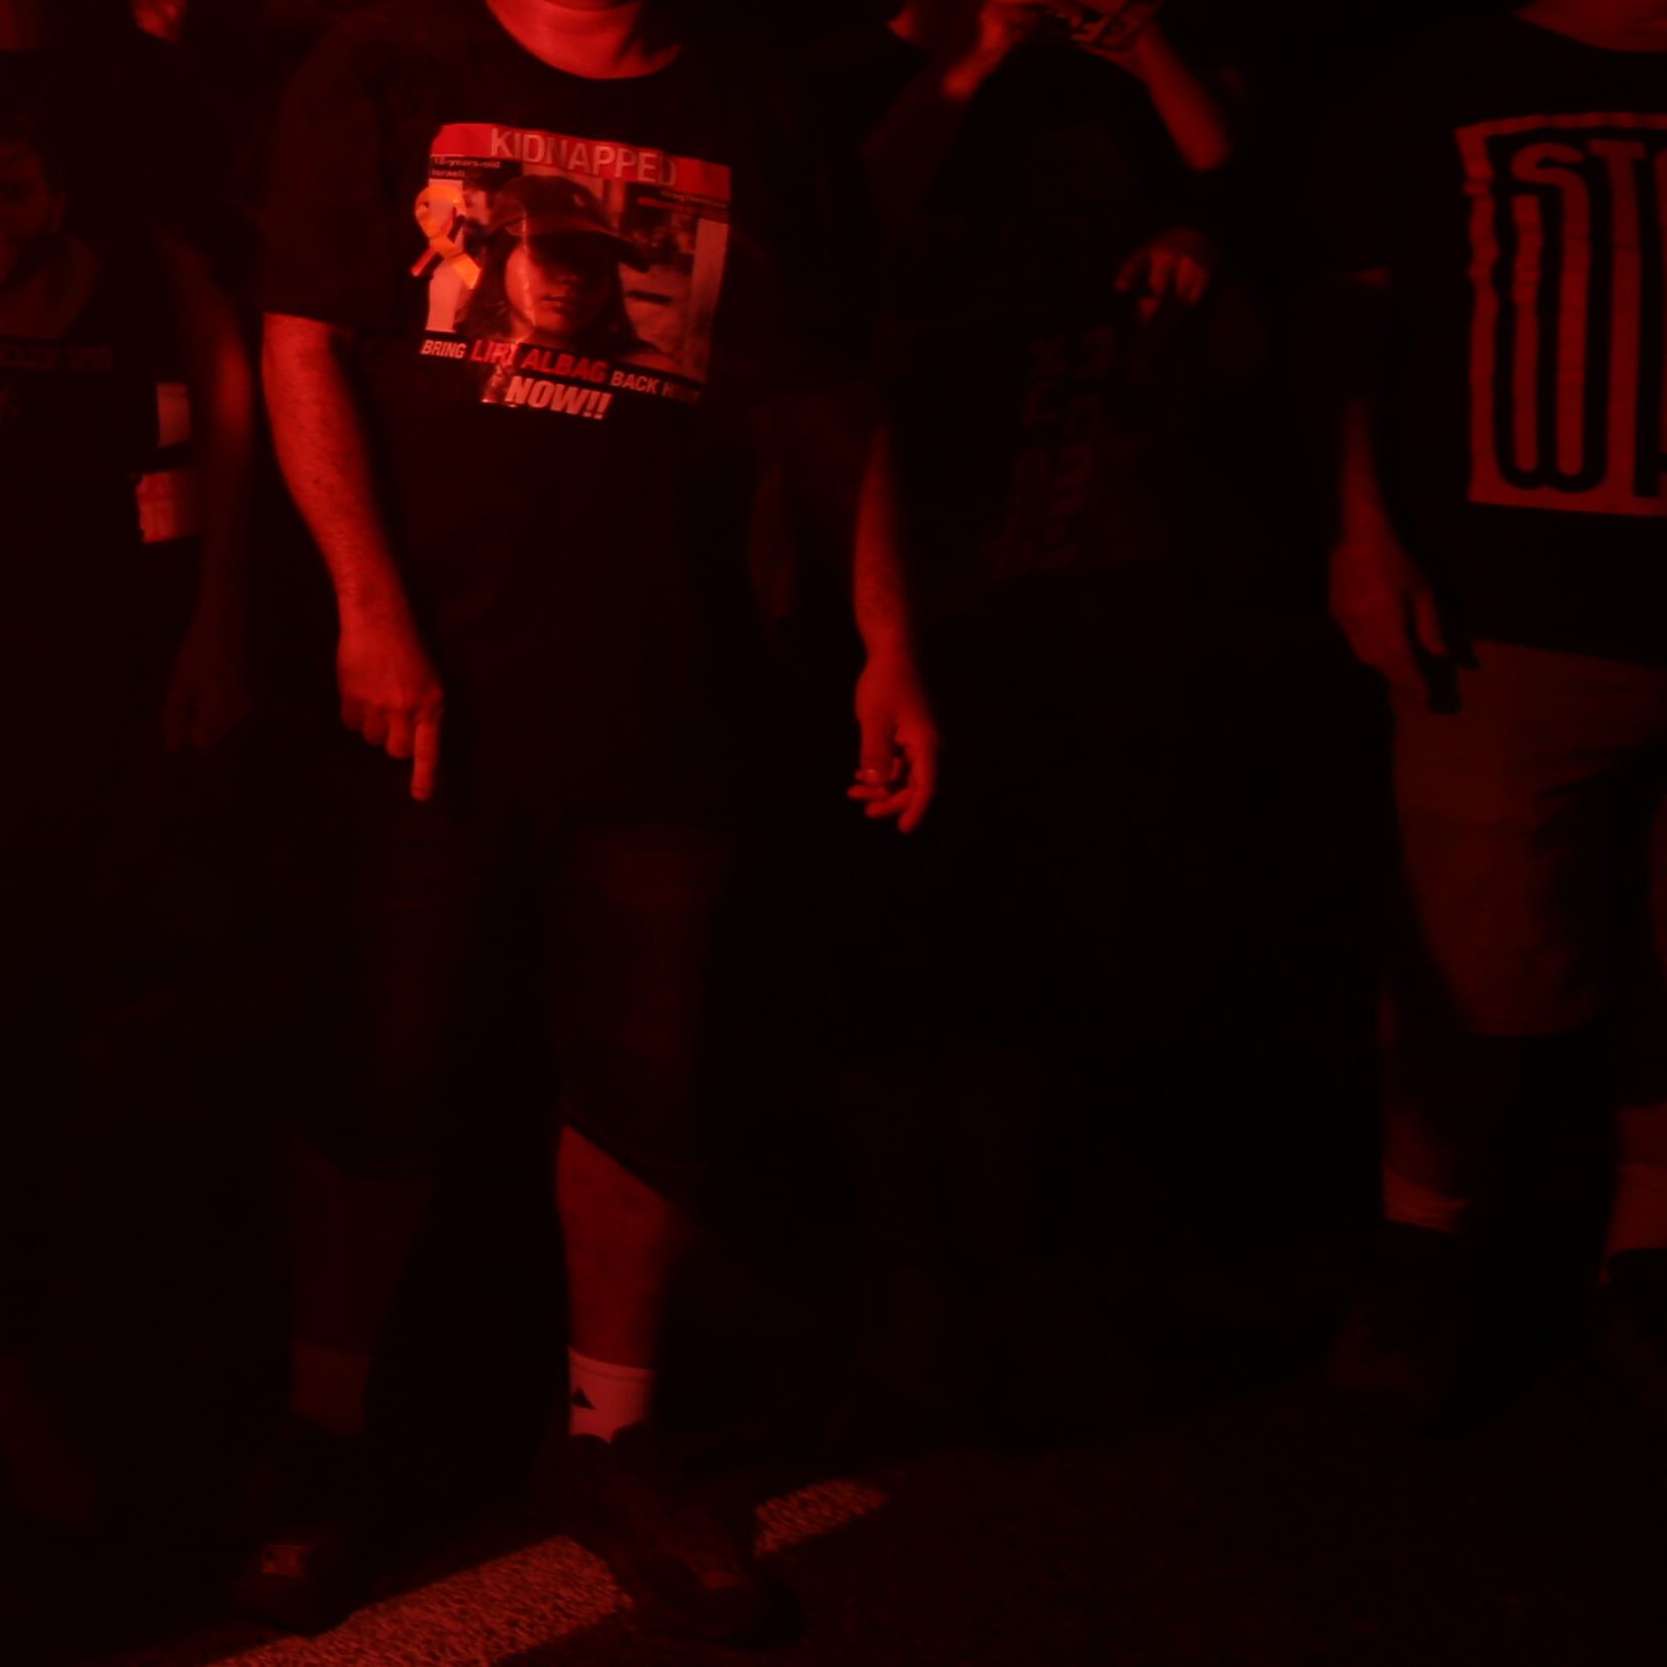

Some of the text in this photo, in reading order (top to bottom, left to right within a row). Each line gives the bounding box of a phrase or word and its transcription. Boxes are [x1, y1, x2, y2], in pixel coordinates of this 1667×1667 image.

[421, 339, 467, 360] BRING
[611, 370, 660, 394] BACK
[506, 375, 614, 421] NOW!!
